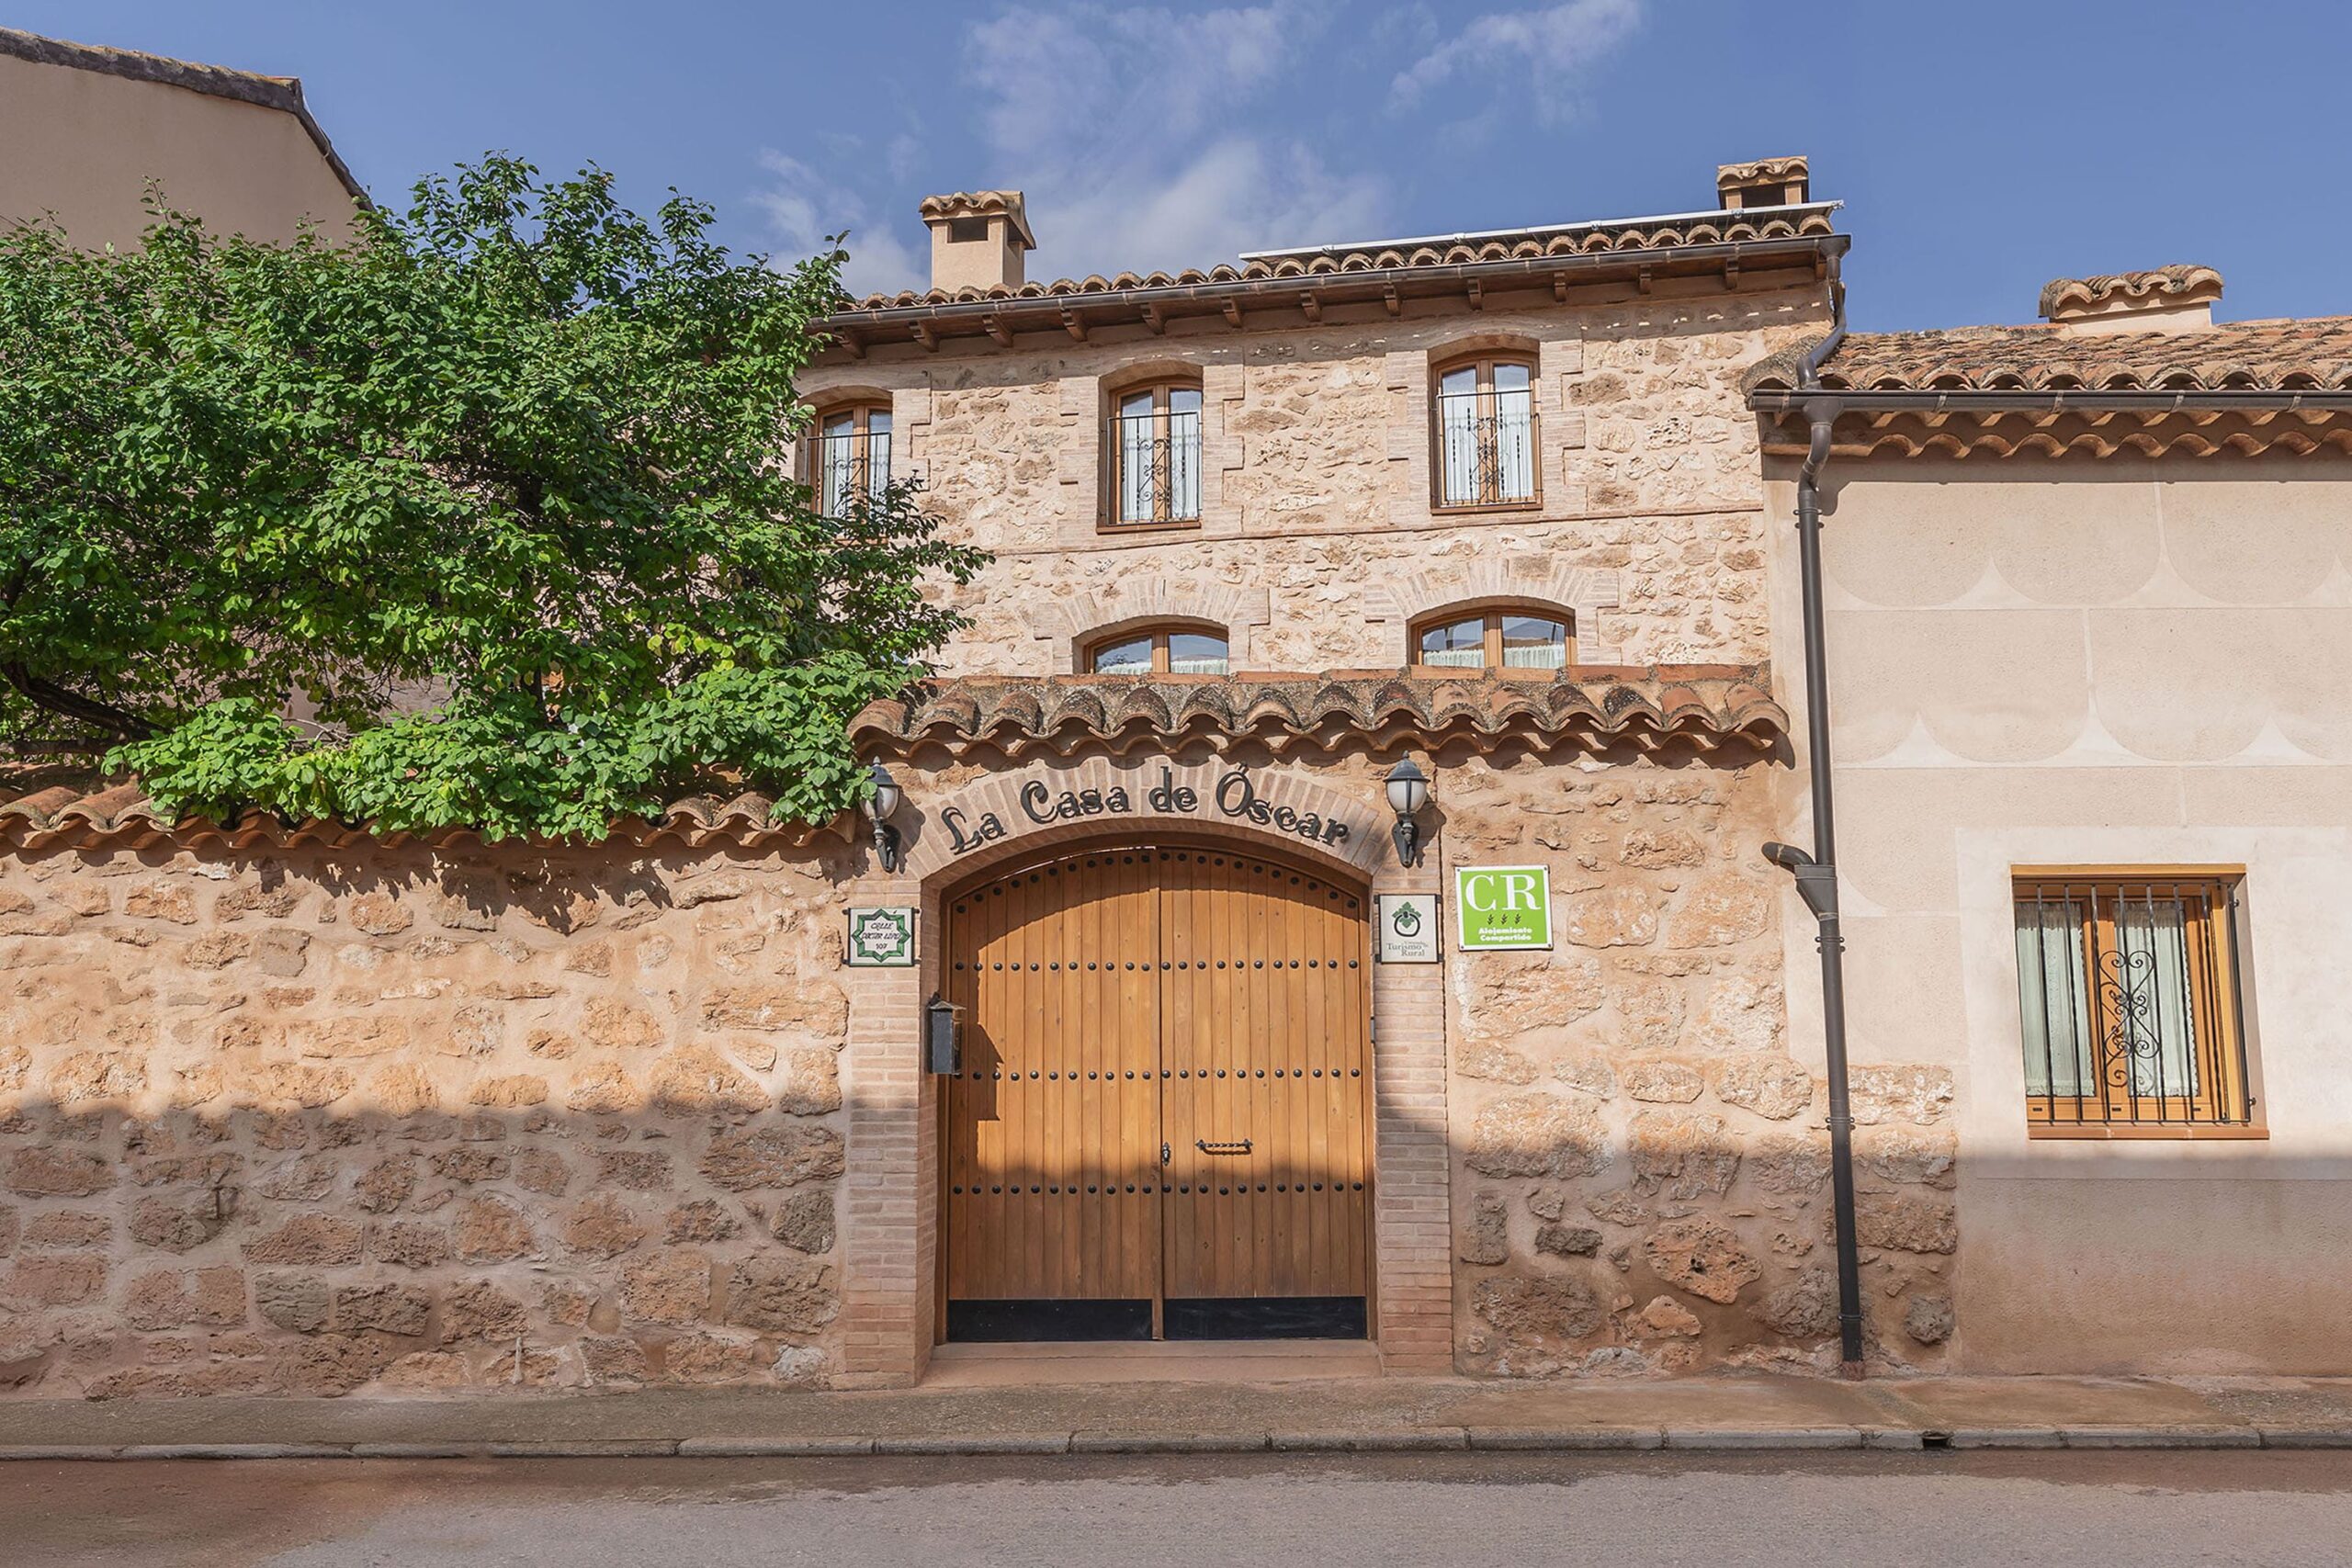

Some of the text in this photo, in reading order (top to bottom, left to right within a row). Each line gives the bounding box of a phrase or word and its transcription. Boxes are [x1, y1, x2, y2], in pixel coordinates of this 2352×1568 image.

[941, 807, 1007, 855] La
[1020, 780, 1132, 825] Casa
[1148, 766, 1198, 813] de
[1465, 874, 1542, 912] CR
[1478, 926, 1532, 936] Alojamiento
[1480, 933, 1532, 942] Compartido
[1385, 942, 1422, 950] Turismo
